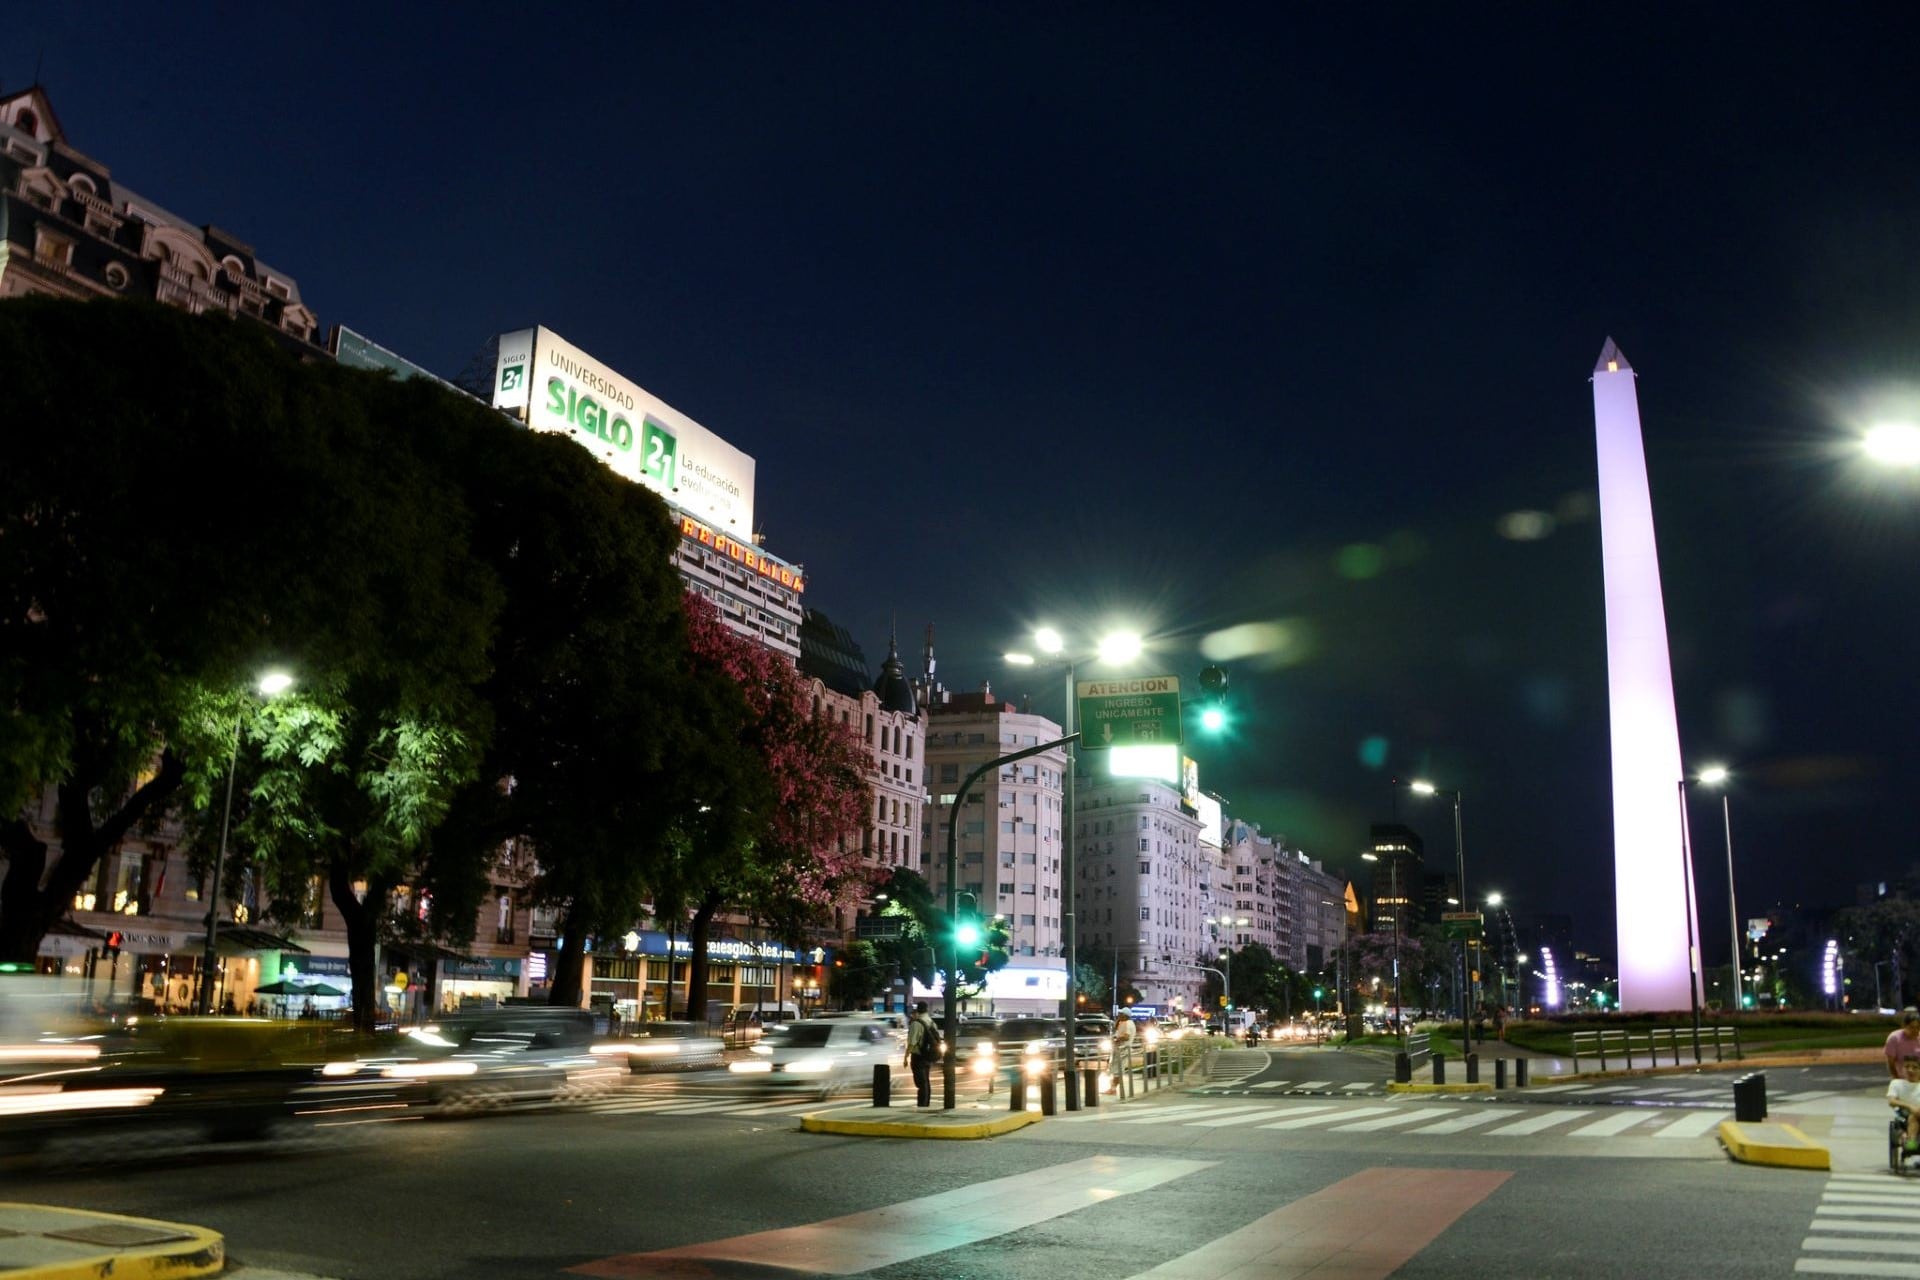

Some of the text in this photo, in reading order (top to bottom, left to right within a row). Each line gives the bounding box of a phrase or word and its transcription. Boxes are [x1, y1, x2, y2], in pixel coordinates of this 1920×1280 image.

[503, 354, 526, 364] SIGLO
[503, 370, 522, 389] 21
[551, 349, 634, 411] UNIVERSIDAD
[547, 376, 674, 488] SIGLO 21
[682, 454, 740, 498] La educación
[682, 517, 803, 592] REPUBLICA
[1088, 680, 1169, 696] ATENCION
[1104, 697, 1152, 709] INGRESO
[1095, 707, 1165, 720] UNICAMENTE
